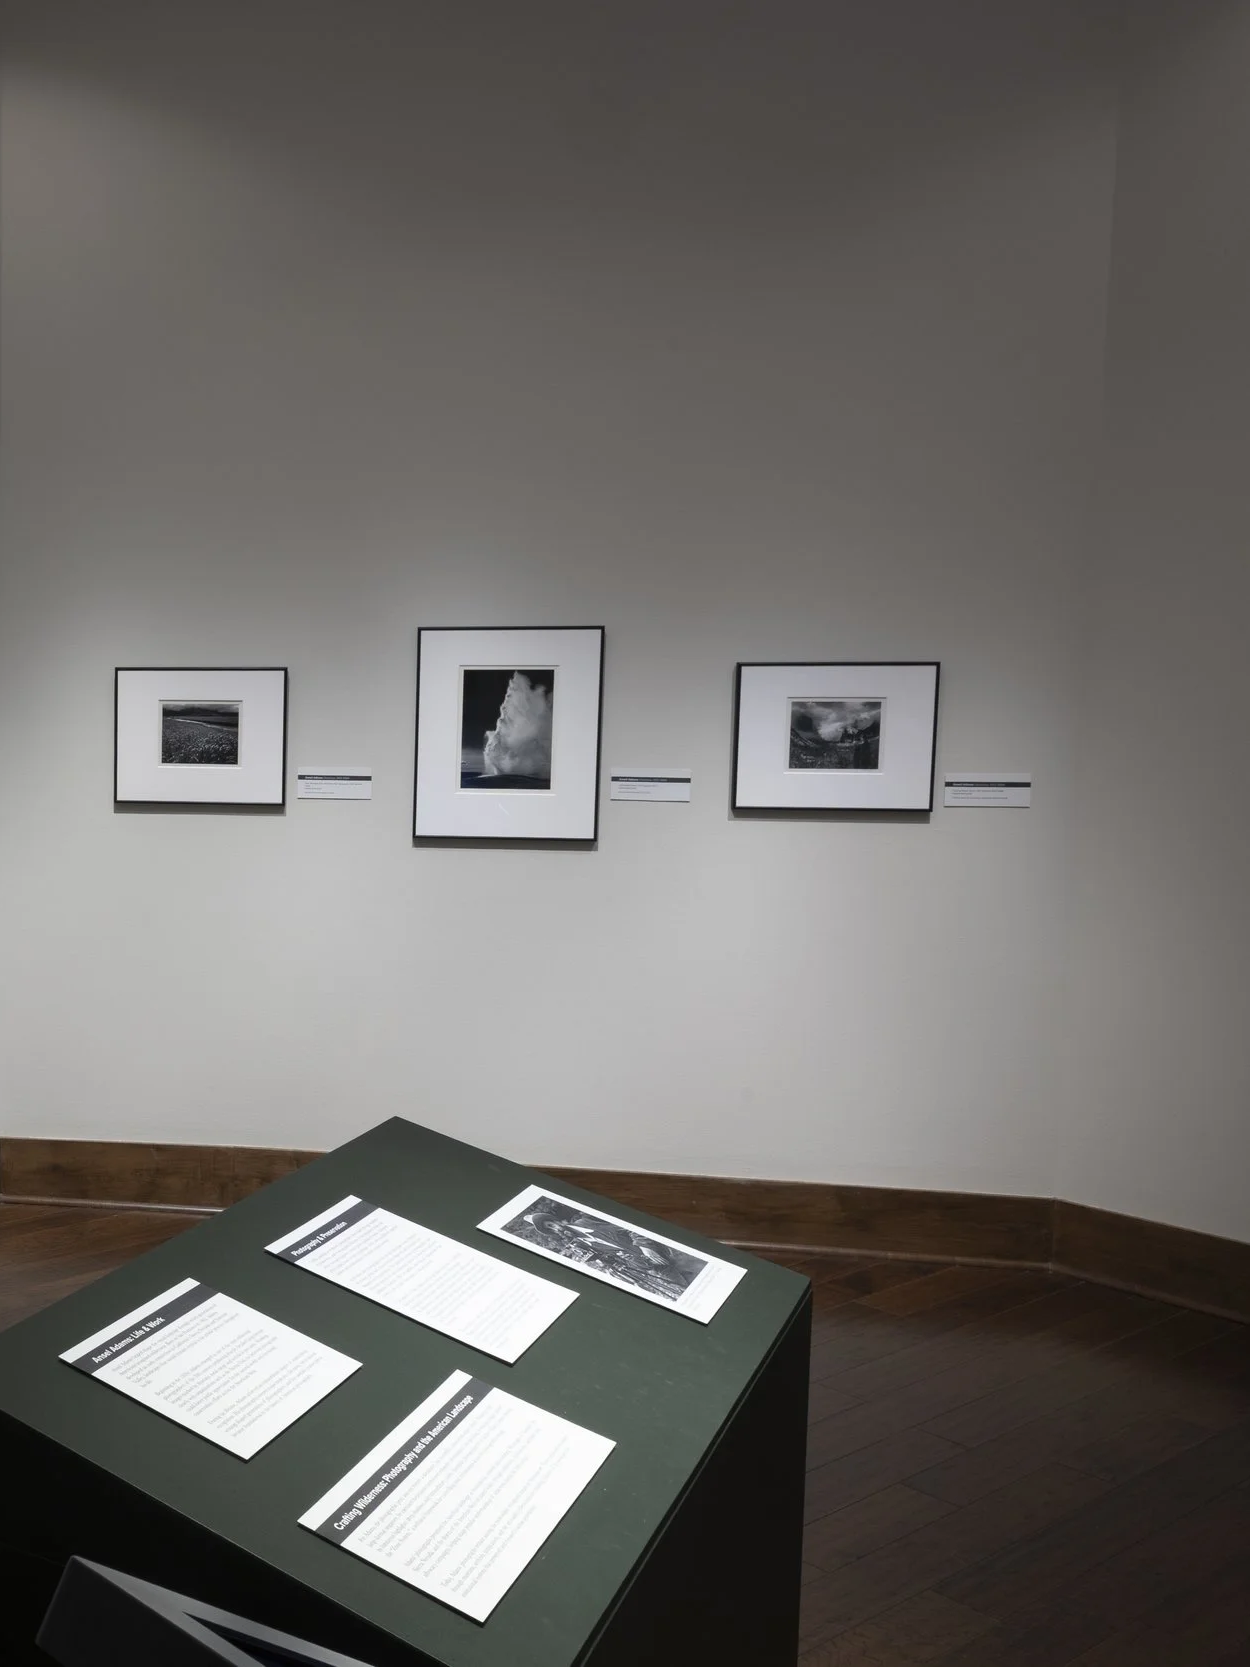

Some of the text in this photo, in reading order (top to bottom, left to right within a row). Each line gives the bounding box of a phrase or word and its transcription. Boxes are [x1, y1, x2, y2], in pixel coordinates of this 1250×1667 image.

[92, 1349, 113, 1363] Ansel
[109, 1336, 135, 1352] Adams:
[130, 1329, 145, 1339] Life
[145, 1317, 165, 1328] Work
[333, 1395, 474, 1530] Crafting Wilderness: Photography and the American Landscape
